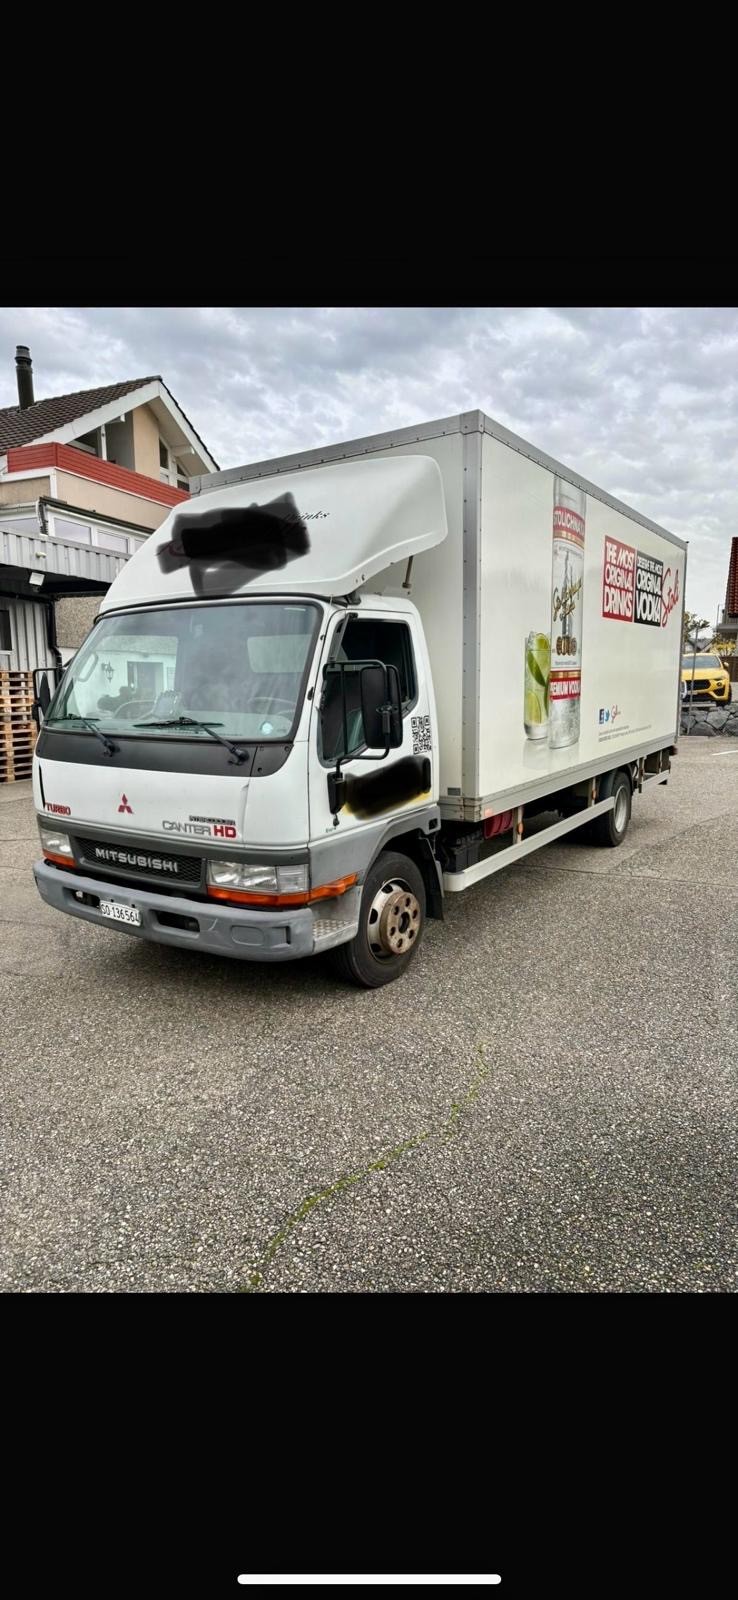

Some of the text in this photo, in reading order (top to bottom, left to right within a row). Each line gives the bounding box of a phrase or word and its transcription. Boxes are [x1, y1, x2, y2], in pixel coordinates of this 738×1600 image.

[606, 541, 617, 564] THE
[617, 547, 635, 571] MOST
[604, 585, 633, 618] DRINKS
[636, 590, 662, 623] VODKA
[45, 802, 71, 816] TURBO
[162, 820, 237, 839] CANTER HD
[95, 847, 178, 873] MITSUBISHI
